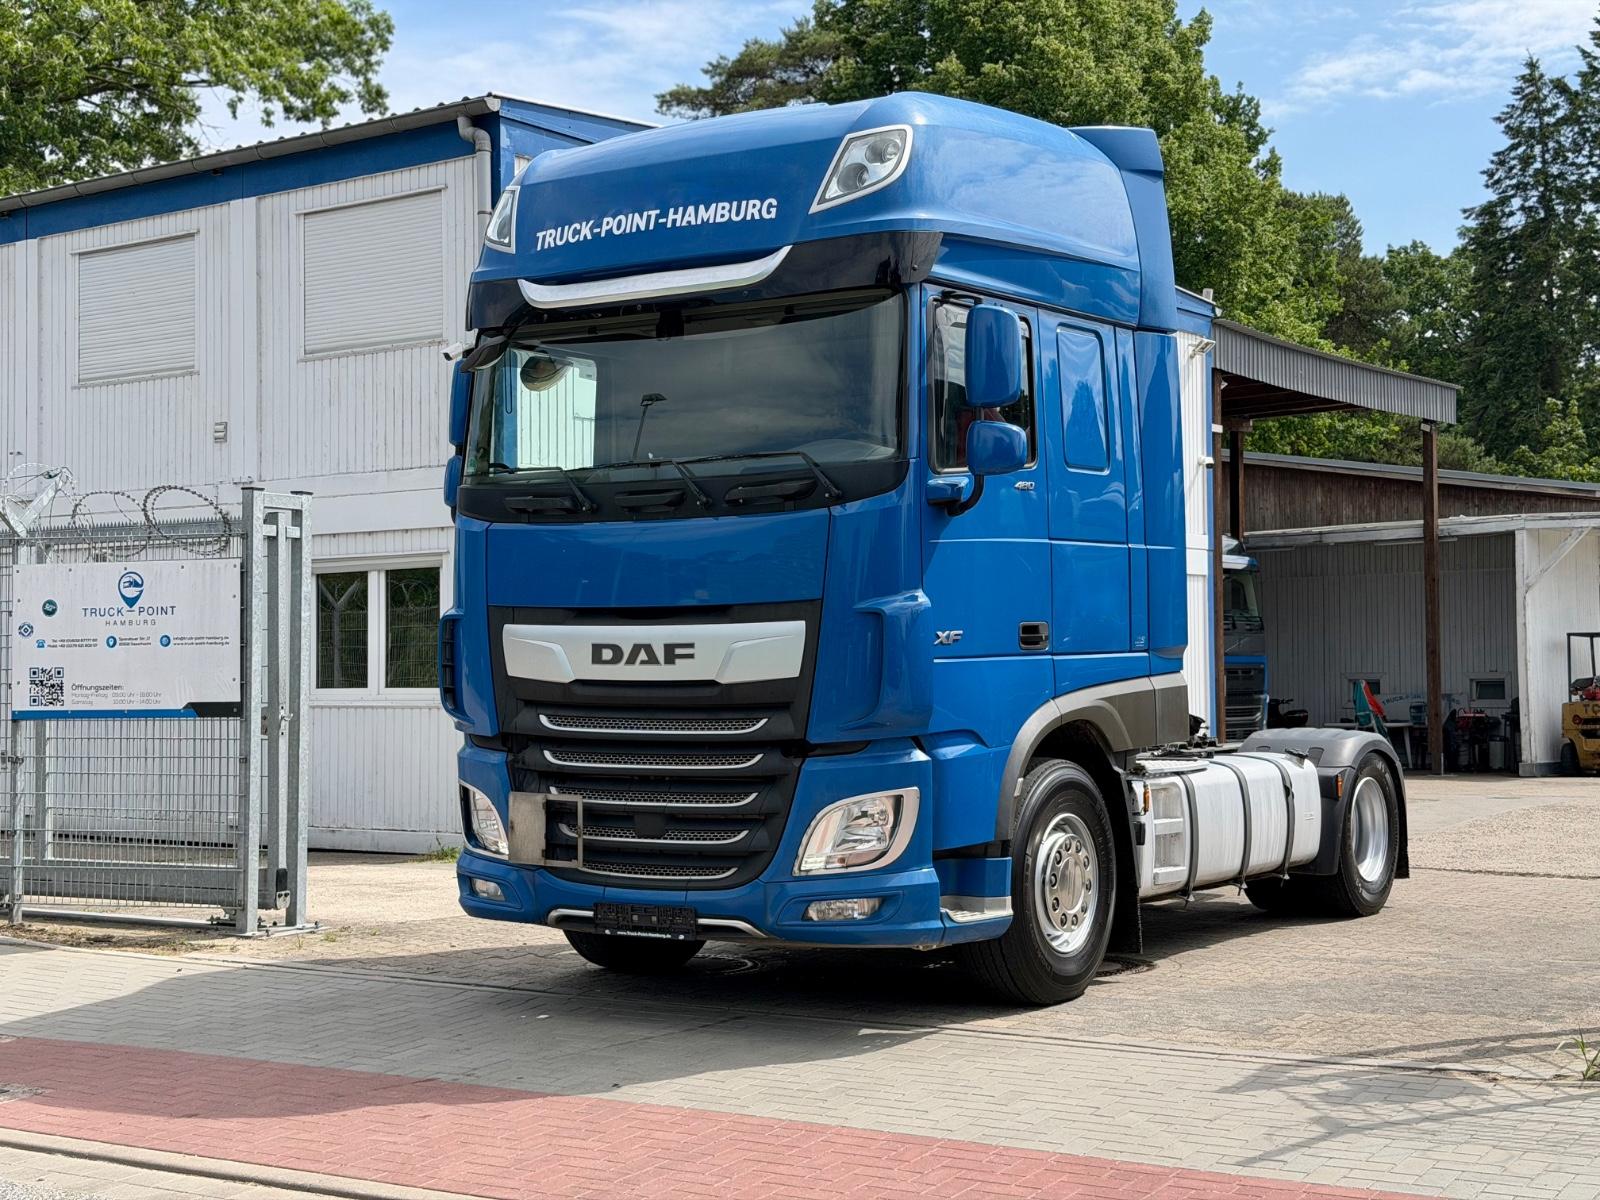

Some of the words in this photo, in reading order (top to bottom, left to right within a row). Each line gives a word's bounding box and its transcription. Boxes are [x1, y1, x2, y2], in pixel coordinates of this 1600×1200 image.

[536, 198, 778, 251] TRUCK-POINT-HAMBURG
[1014, 481, 1035, 490] 480
[934, 630, 963, 644] XF
[591, 643, 695, 665] DAF
